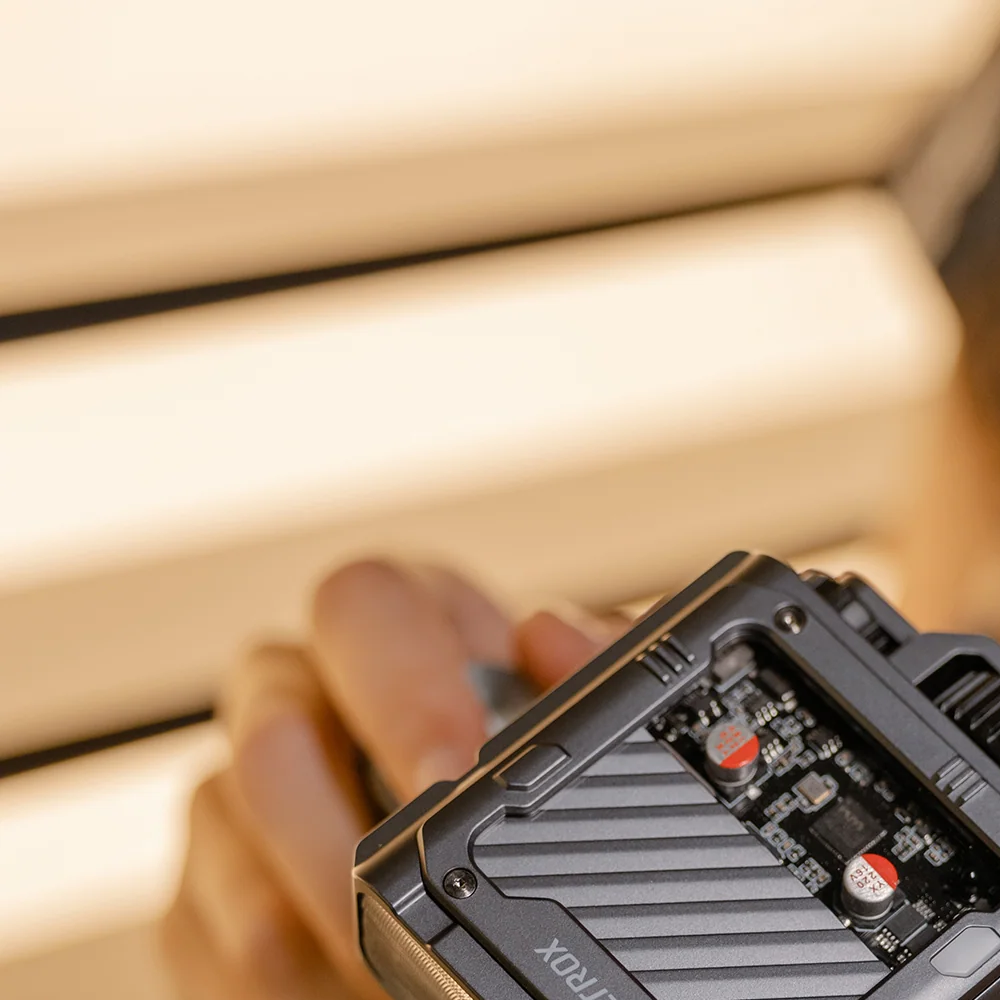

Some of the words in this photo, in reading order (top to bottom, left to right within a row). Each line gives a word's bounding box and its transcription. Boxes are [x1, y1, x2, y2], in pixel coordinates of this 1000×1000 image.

[849, 864, 869, 882] 16V
[856, 871, 877, 889] 220
[868, 880, 886, 893] YX
